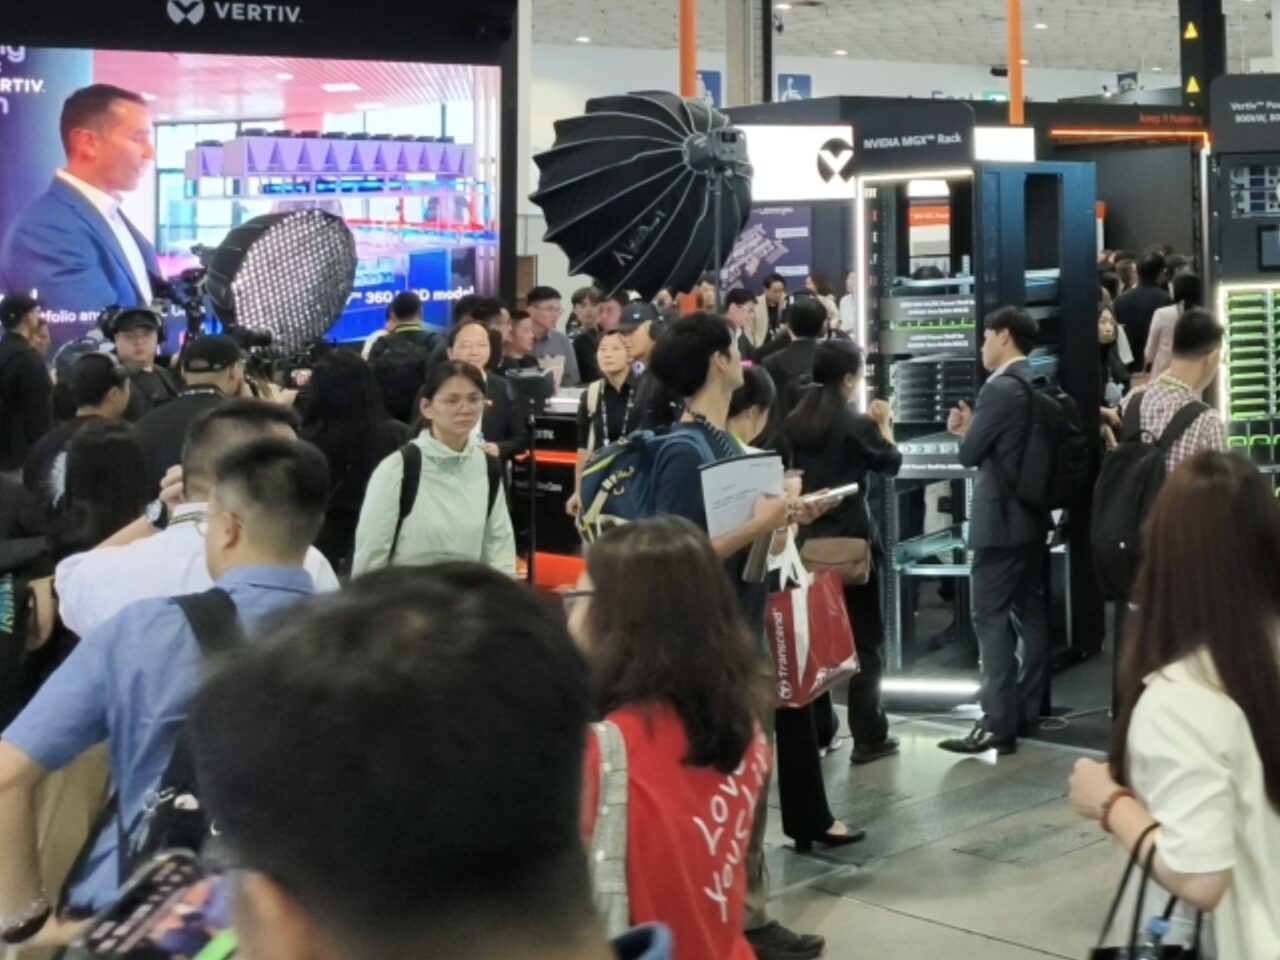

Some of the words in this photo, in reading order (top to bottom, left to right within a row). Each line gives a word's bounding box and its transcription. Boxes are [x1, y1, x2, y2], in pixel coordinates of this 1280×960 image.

[863, 137, 900, 149] NVIDIA
[937, 132, 962, 144] Rack
[772, 610, 789, 677] Transcend
